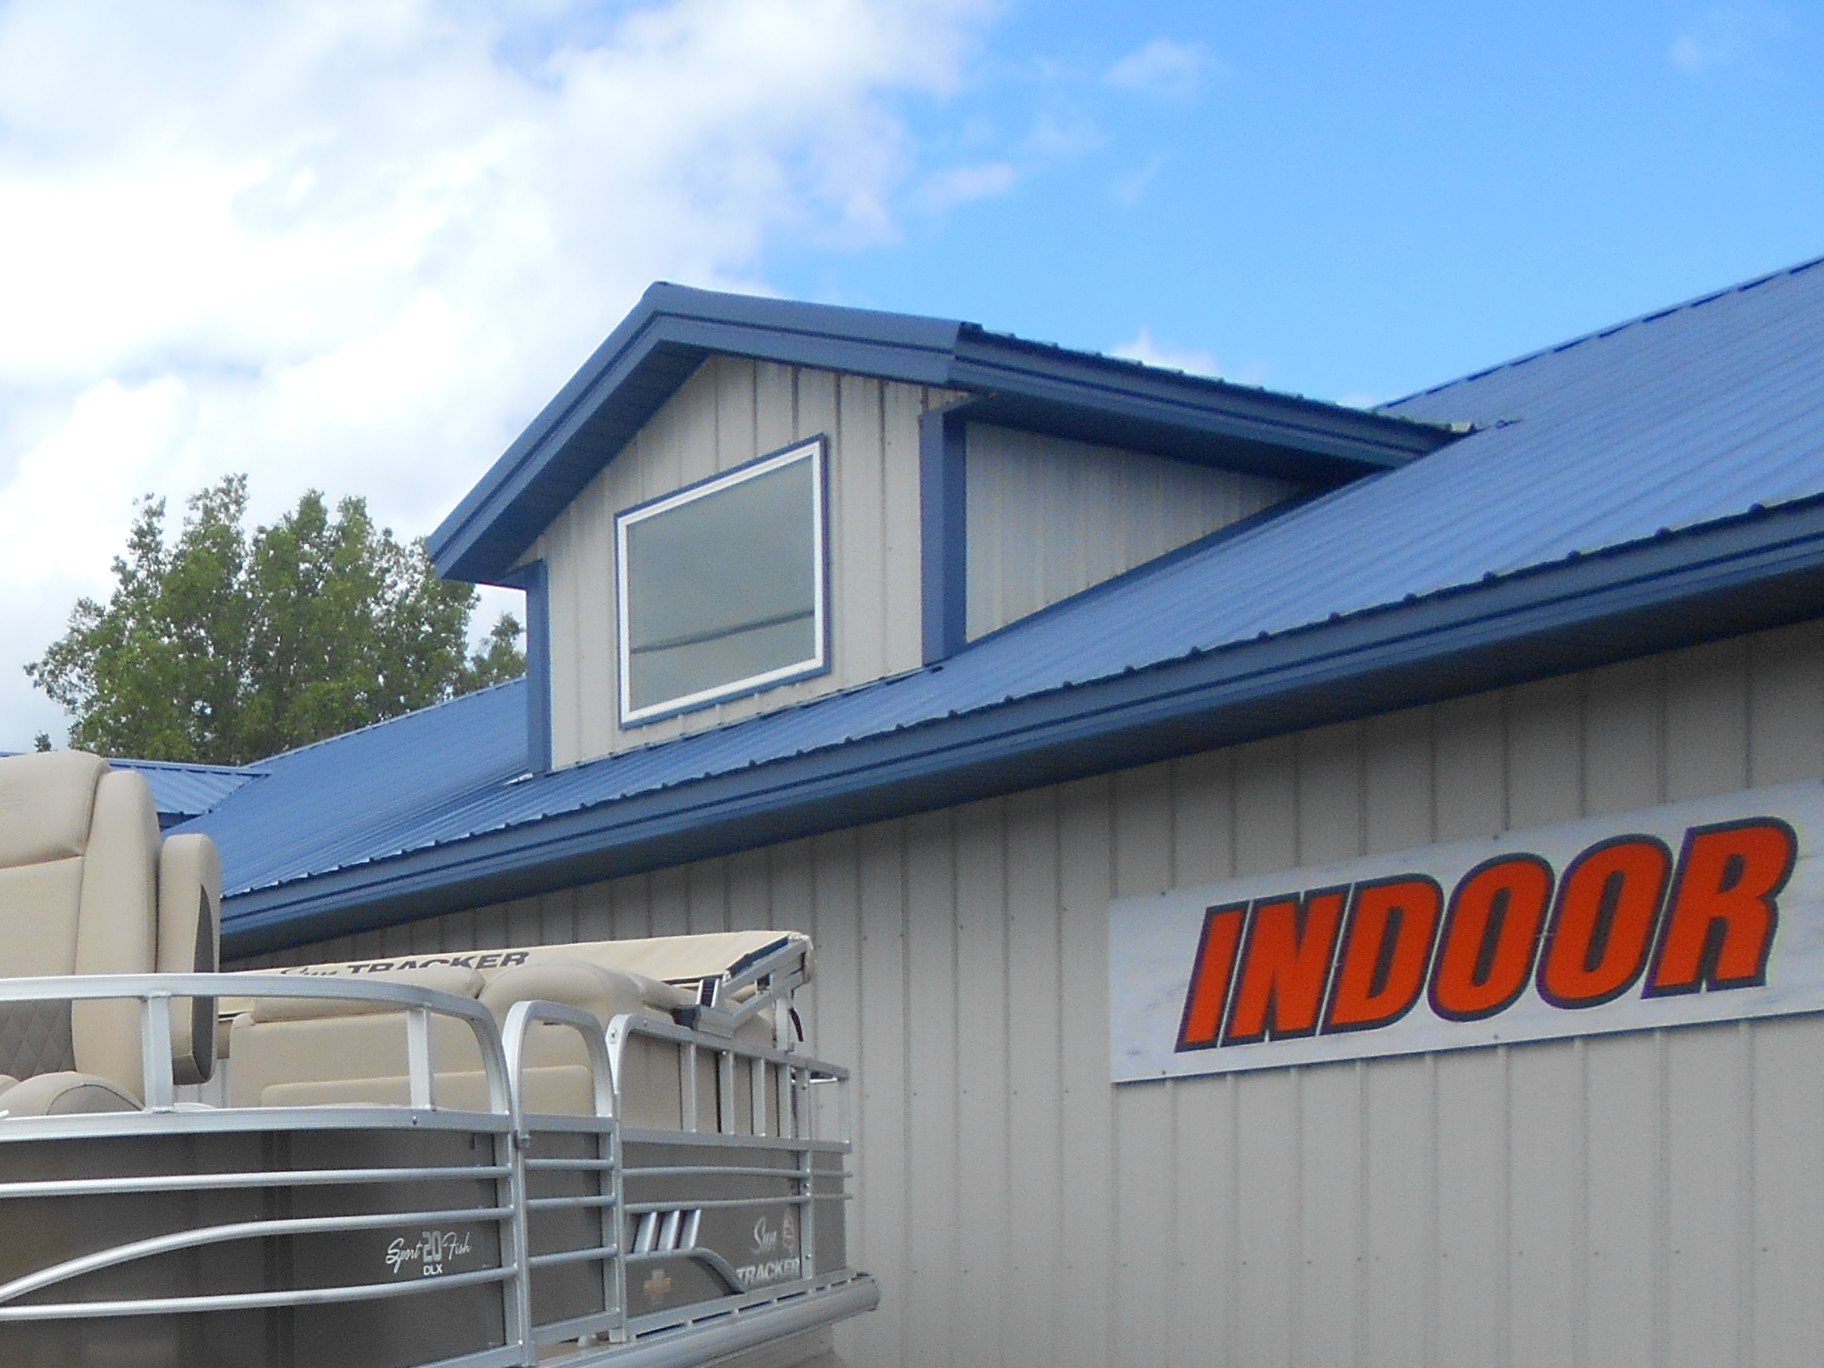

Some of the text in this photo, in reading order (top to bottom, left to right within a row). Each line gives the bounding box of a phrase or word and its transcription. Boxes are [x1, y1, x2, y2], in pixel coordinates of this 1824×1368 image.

[1175, 816, 1798, 1053] INDOOR
[385, 1230, 472, 1274] Sport 20 Fish
[423, 1264, 443, 1276] DLX
[736, 1257, 800, 1285] TRACKER
